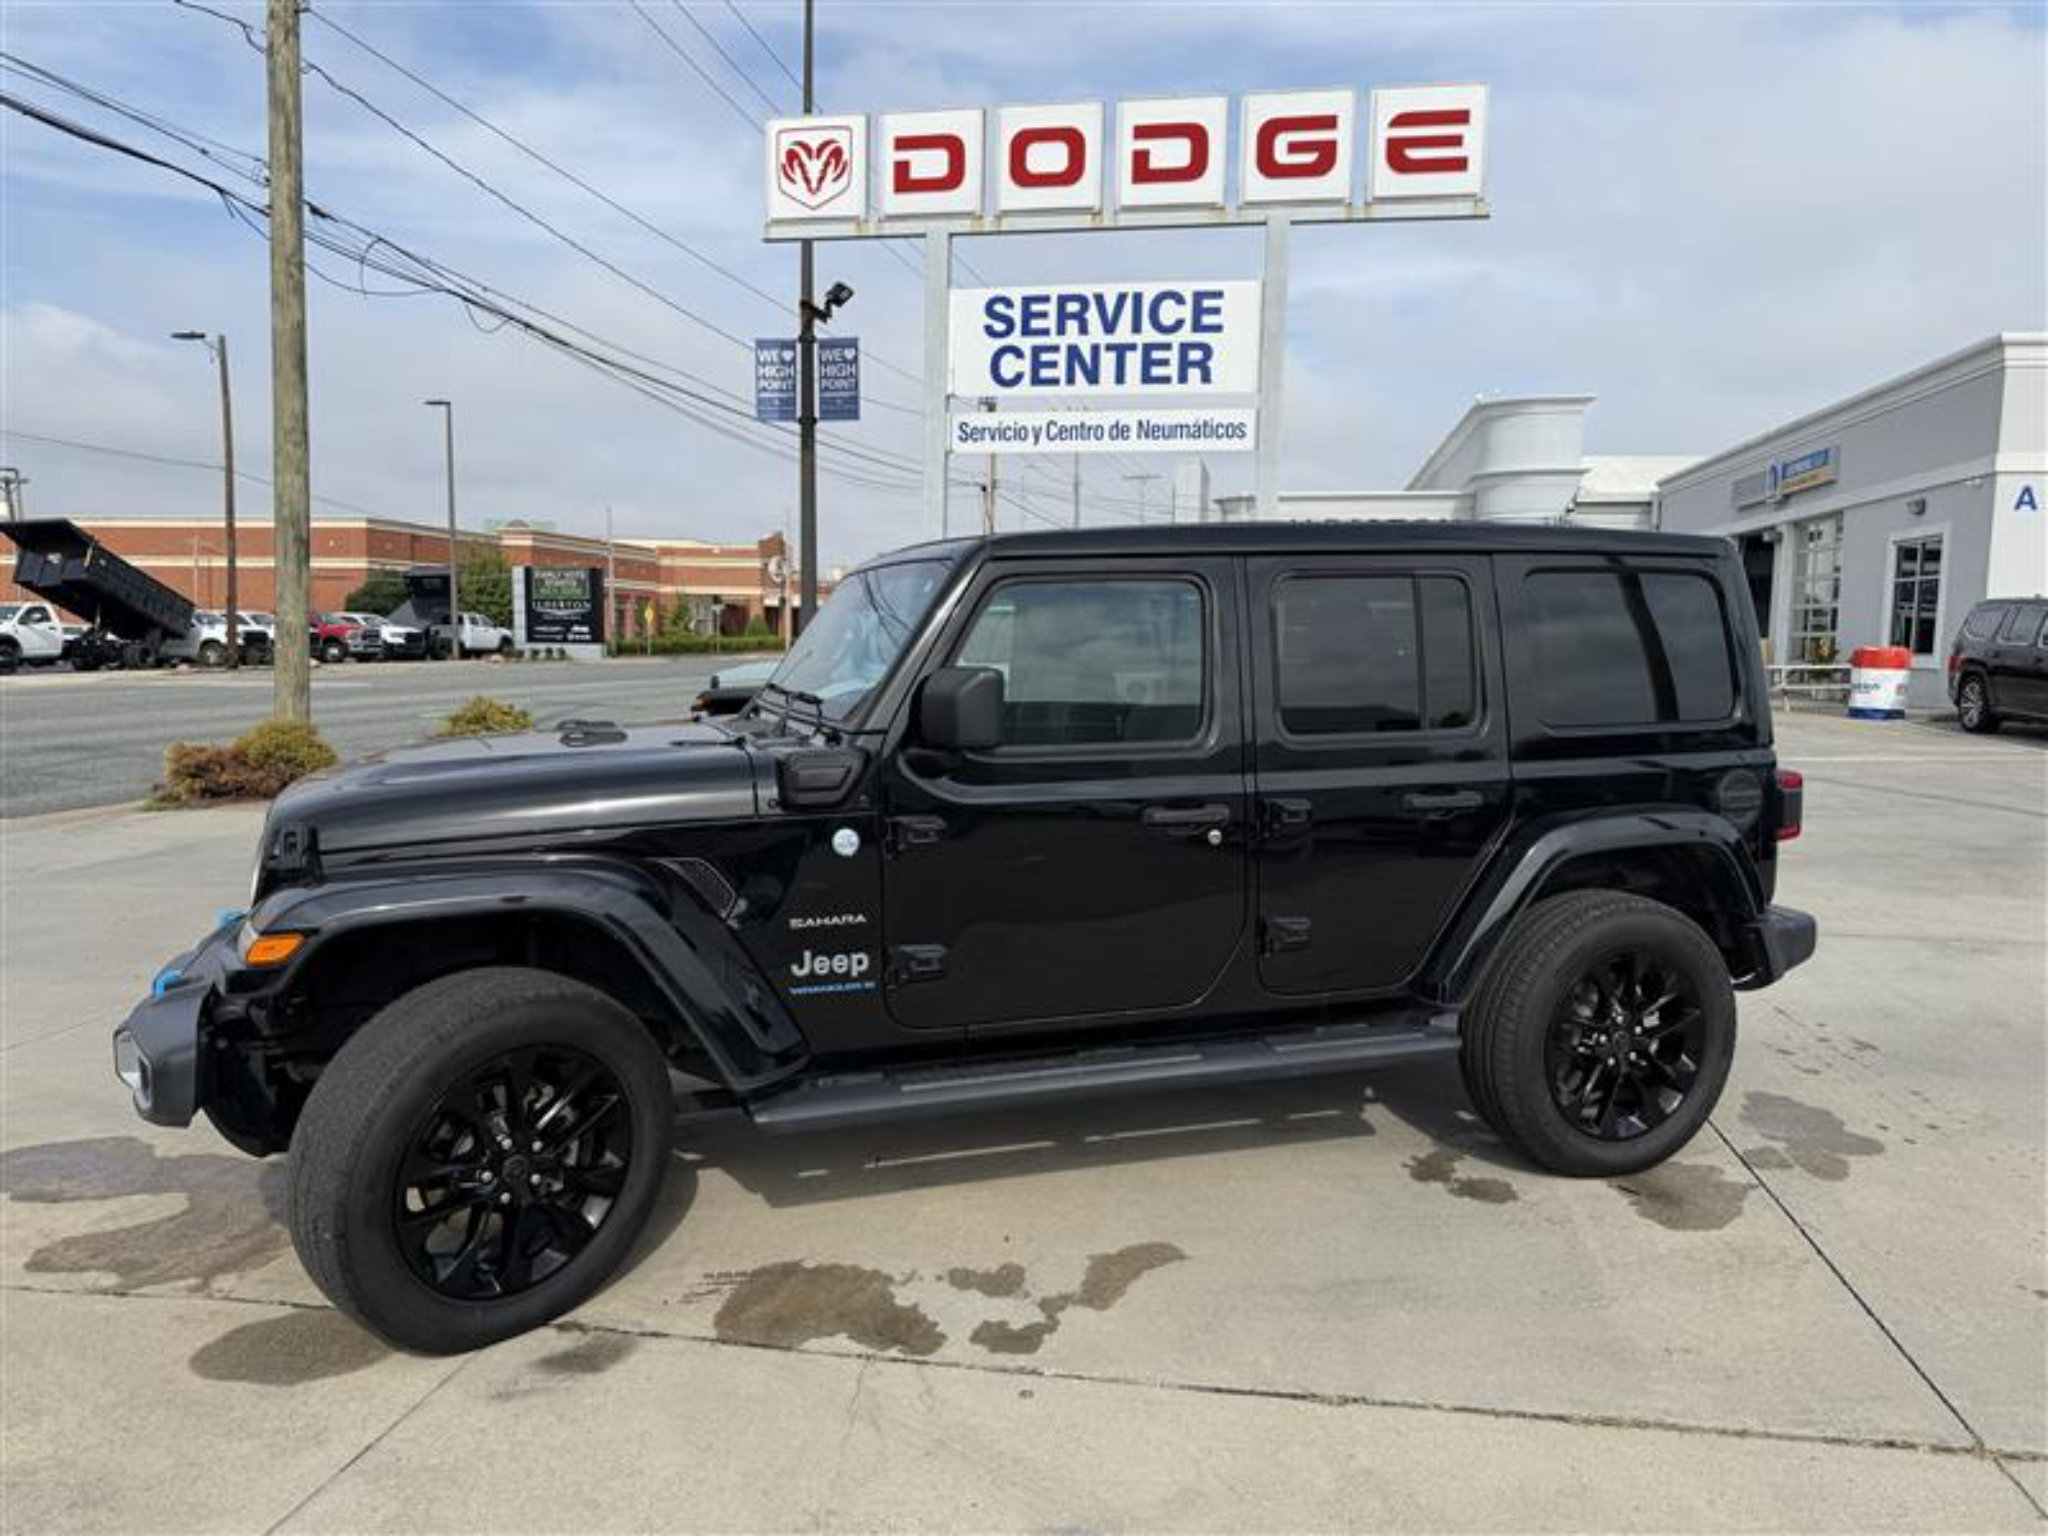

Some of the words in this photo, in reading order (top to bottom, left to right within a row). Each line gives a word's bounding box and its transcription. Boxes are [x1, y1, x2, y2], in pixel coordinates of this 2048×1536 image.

[893, 108, 1471, 194] DODGE
[982, 289, 1225, 339] SERVICE
[757, 349, 779, 362] WE
[821, 347, 843, 361] WE
[757, 364, 795, 378] HIGH
[821, 363, 856, 377] HIGH
[989, 341, 1214, 388] CENTER
[758, 379, 795, 390] POINT
[821, 378, 856, 390] POINT
[957, 419, 1028, 444] Servicio
[1031, 424, 1043, 447] y
[1046, 418, 1105, 442] Centro
[1108, 418, 1131, 441] de
[1136, 417, 1248, 441] Neumáticos
[2014, 485, 2038, 511] A
[788, 913, 867, 930] SAHARA
[790, 949, 870, 978] Jeep
